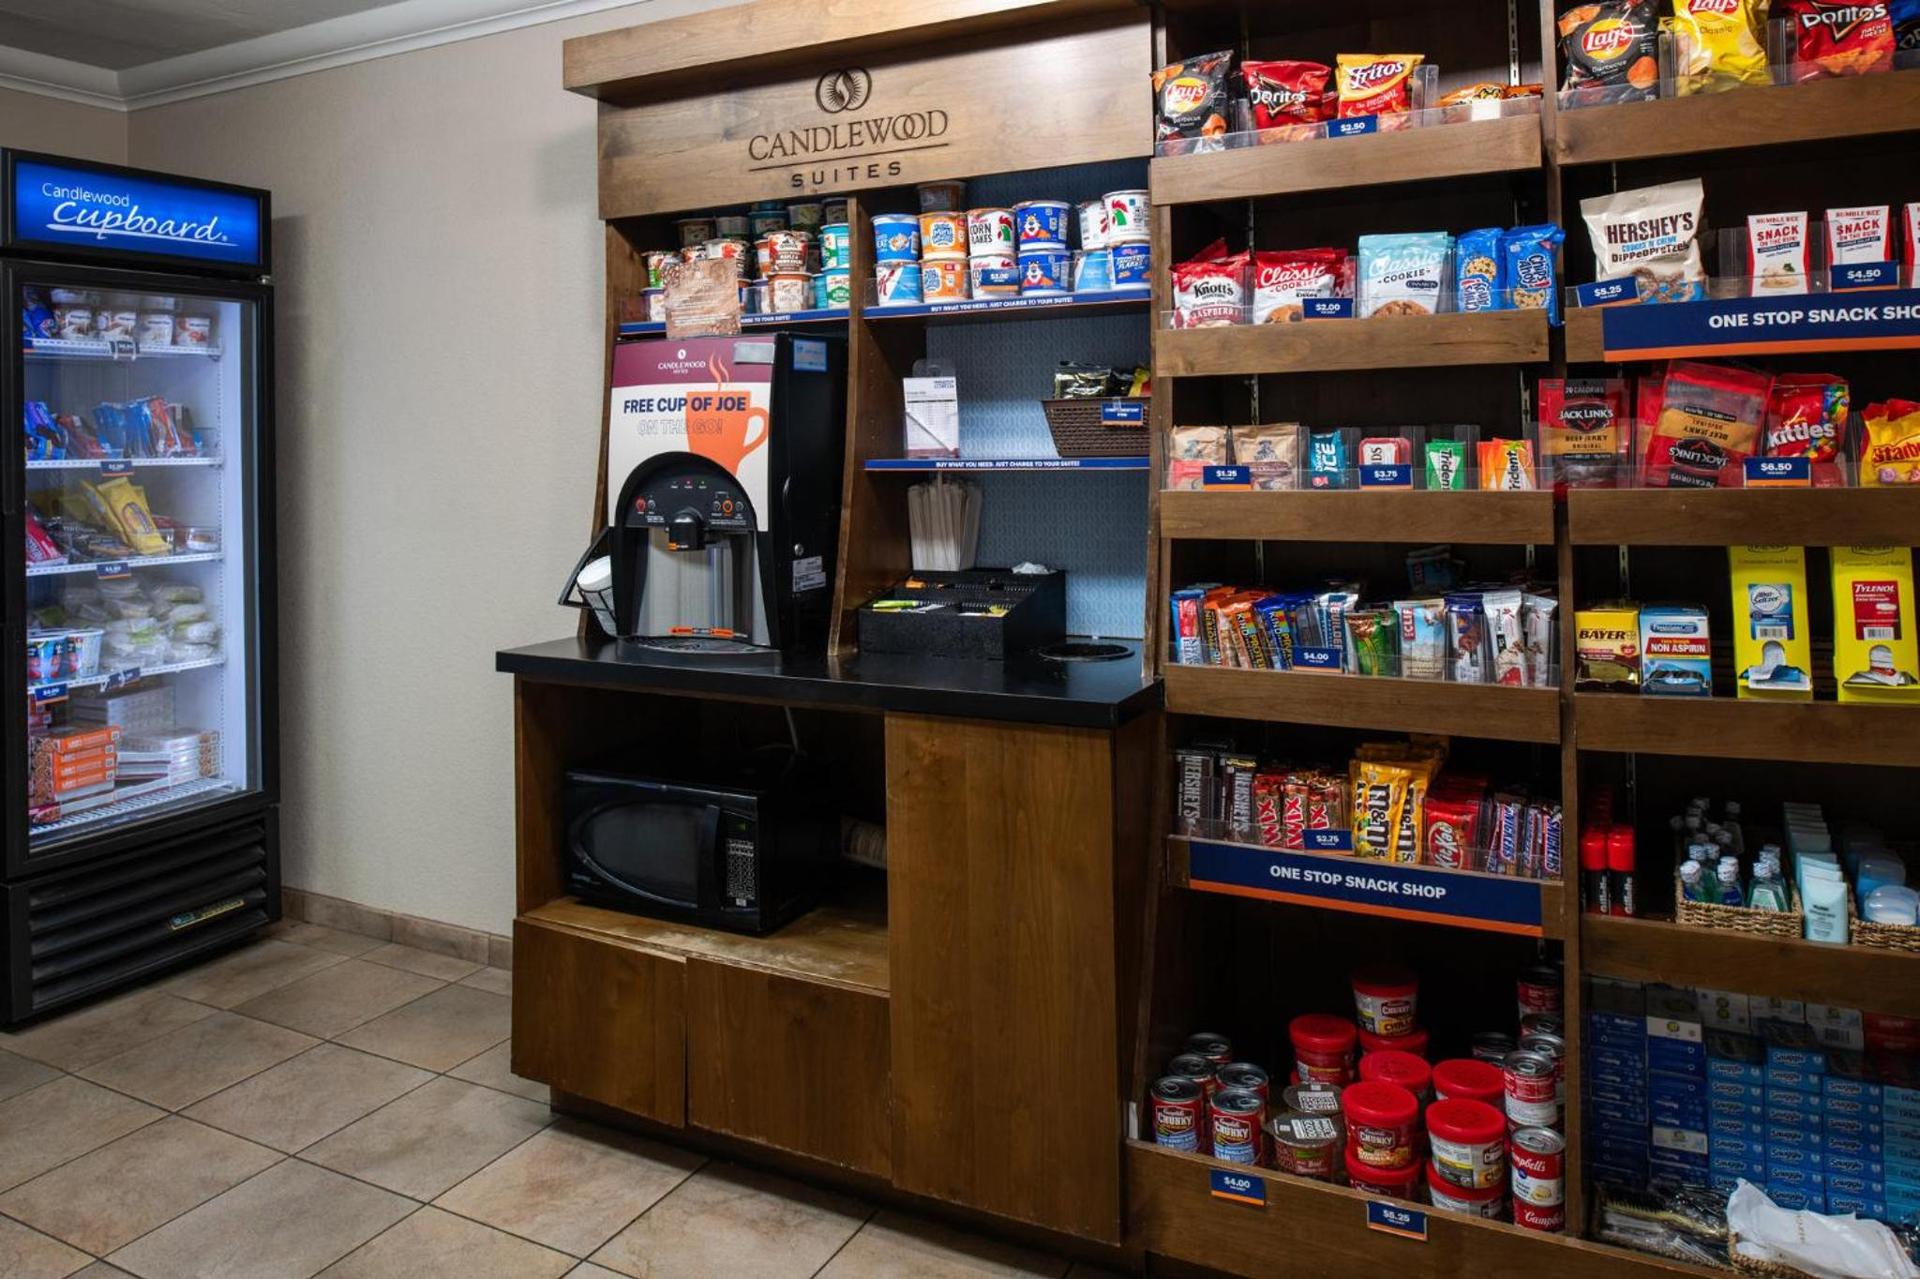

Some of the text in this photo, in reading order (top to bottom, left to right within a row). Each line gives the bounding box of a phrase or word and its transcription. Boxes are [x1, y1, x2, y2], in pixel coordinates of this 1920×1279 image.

[1803, 4, 1887, 28] Doritos
[1349, 60, 1404, 89] Fritos
[1250, 85, 1306, 105] Doritos
[749, 109, 948, 161] CANDLEWOOD
[1341, 122, 1365, 132] $2.50
[792, 160, 901, 187] SUITES
[42, 183, 130, 207] Candlewood
[1756, 215, 1799, 225] BUMBLE BEE
[1836, 209, 1881, 219] BUMBLE BEE
[970, 223, 992, 235] CORN
[1607, 212, 1693, 244] HERSHEY'S
[1757, 225, 1799, 242] SNACK
[1836, 219, 1880, 236] SNACK
[1369, 250, 1439, 275] Classic
[1529, 255, 1549, 282] Chips
[1261, 263, 1325, 285] Classic
[1383, 269, 1425, 284] COOKIE
[1847, 269, 1881, 280] $4.50
[1194, 281, 1235, 298] Knott's
[1594, 285, 1622, 298] $5.25
[1054, 296, 1074, 304] SUITE!
[1315, 303, 1341, 312] $2.00
[1709, 312, 1749, 329] ONE
[1752, 310, 1804, 327] STOP
[1808, 307, 1879, 323] SNACK
[658, 360, 706, 371] CANDLEWOOD
[624, 395, 747, 414] FREE CUP OF JOE
[1559, 407, 1614, 421] JACK LINK'S
[637, 417, 723, 436] ON THE GO!
[1767, 421, 1836, 449] kittles
[1565, 434, 1608, 442] BEEF JERKY
[1320, 441, 1339, 473] ICE
[1668, 446, 1728, 467] JACK LINK'S
[1216, 470, 1237, 478] $1.25
[1374, 470, 1397, 479] $3.75
[1507, 450, 1521, 491] rident
[1760, 463, 1792, 472] $6.50
[1855, 583, 1895, 594] TYLENOL
[1237, 613, 1250, 636] KIND
[1268, 612, 1284, 635] KIND
[1403, 608, 1414, 633] CLIF
[1579, 630, 1626, 640] BAYER
[1304, 652, 1329, 661] $4.00
[1651, 643, 1706, 653] NON ASPIRIN
[1183, 754, 1201, 820] HERSHEY'S
[1233, 772, 1252, 832] HERSHEY'S
[1258, 799, 1282, 845] WIX
[1316, 835, 1340, 843] $2.75
[1502, 803, 1516, 862] SNICKERS
[1545, 818, 1561, 874] SNICKERS
[1270, 865, 1447, 899] ONE STOP SNACK SHOP
[1623, 876, 1633, 915] Gillette
[1157, 1113, 1193, 1127] CHUNKY
[1214, 1121, 1249, 1139] CHUNKY
[1358, 1132, 1393, 1147] CHUNKY
[1223, 1176, 1251, 1189] $4.00
